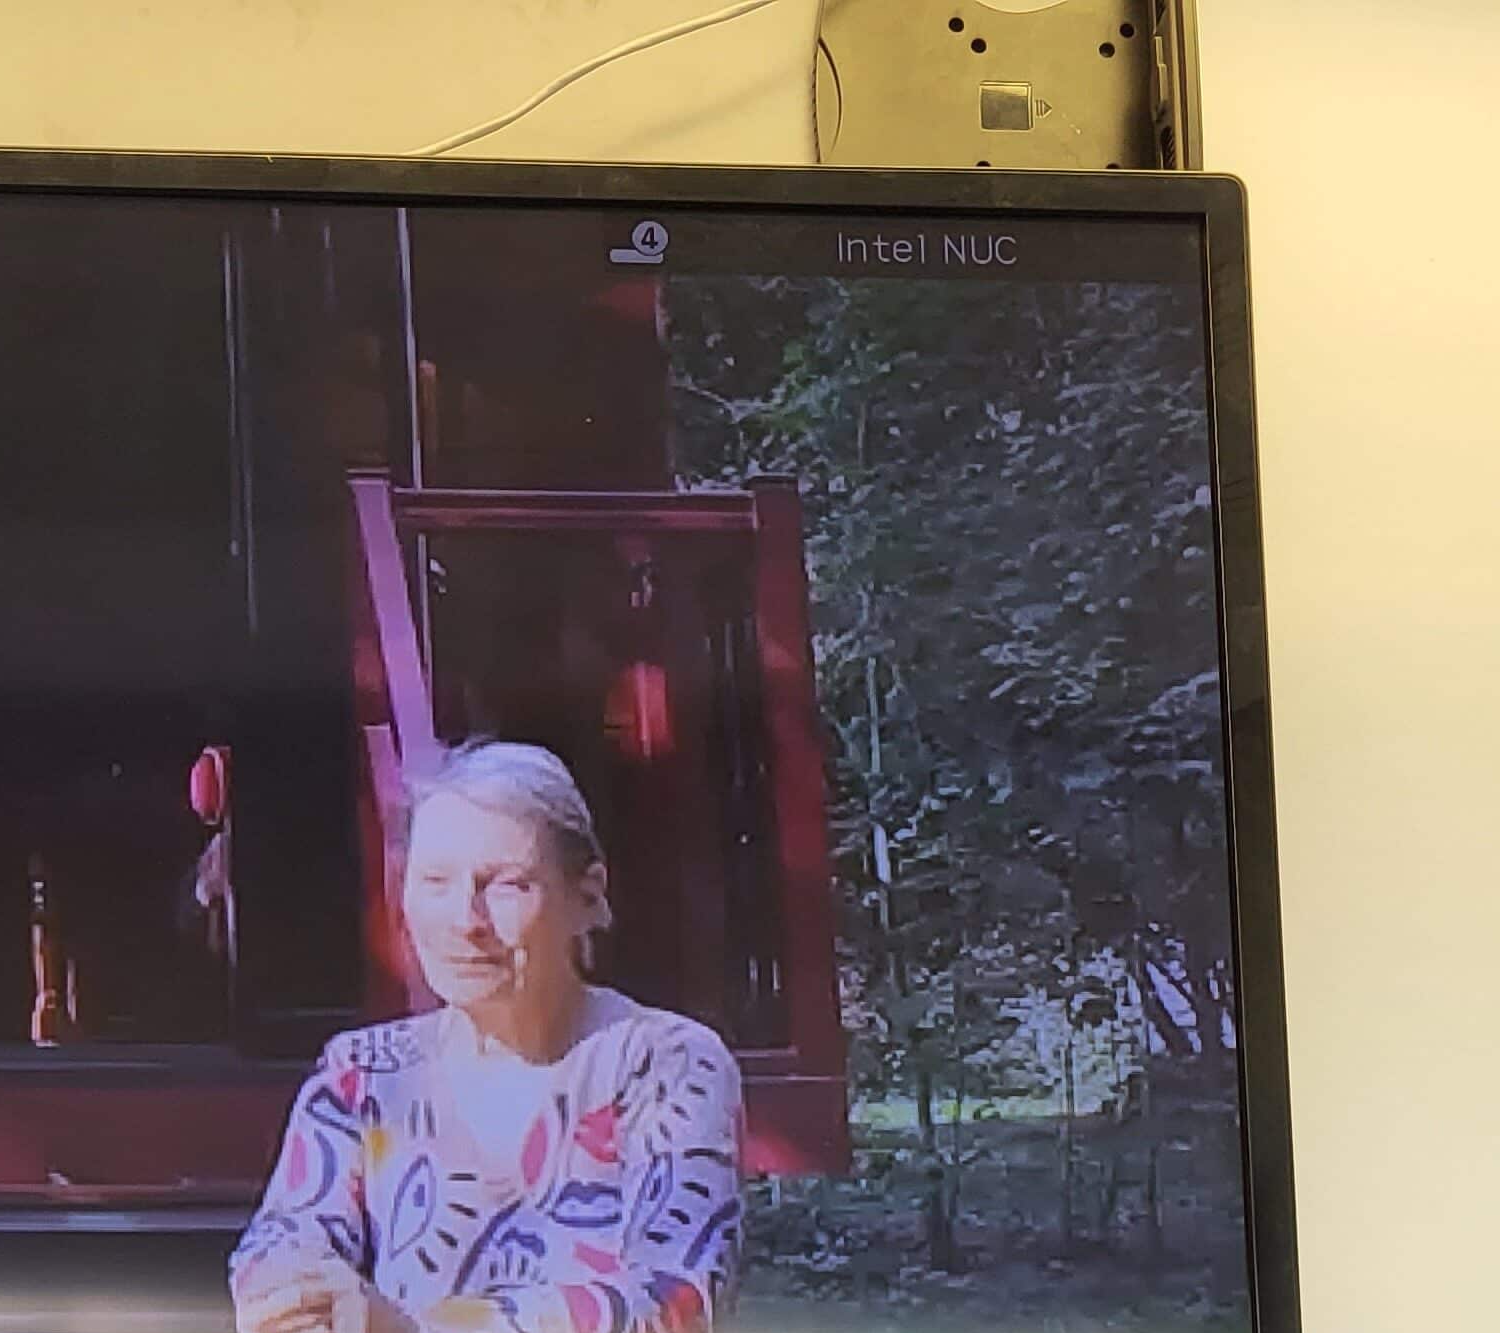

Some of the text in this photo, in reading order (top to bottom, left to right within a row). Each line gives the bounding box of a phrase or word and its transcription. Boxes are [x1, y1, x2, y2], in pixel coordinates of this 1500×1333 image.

[640, 226, 659, 249] 4
[835, 231, 1018, 266] Intel NUC
